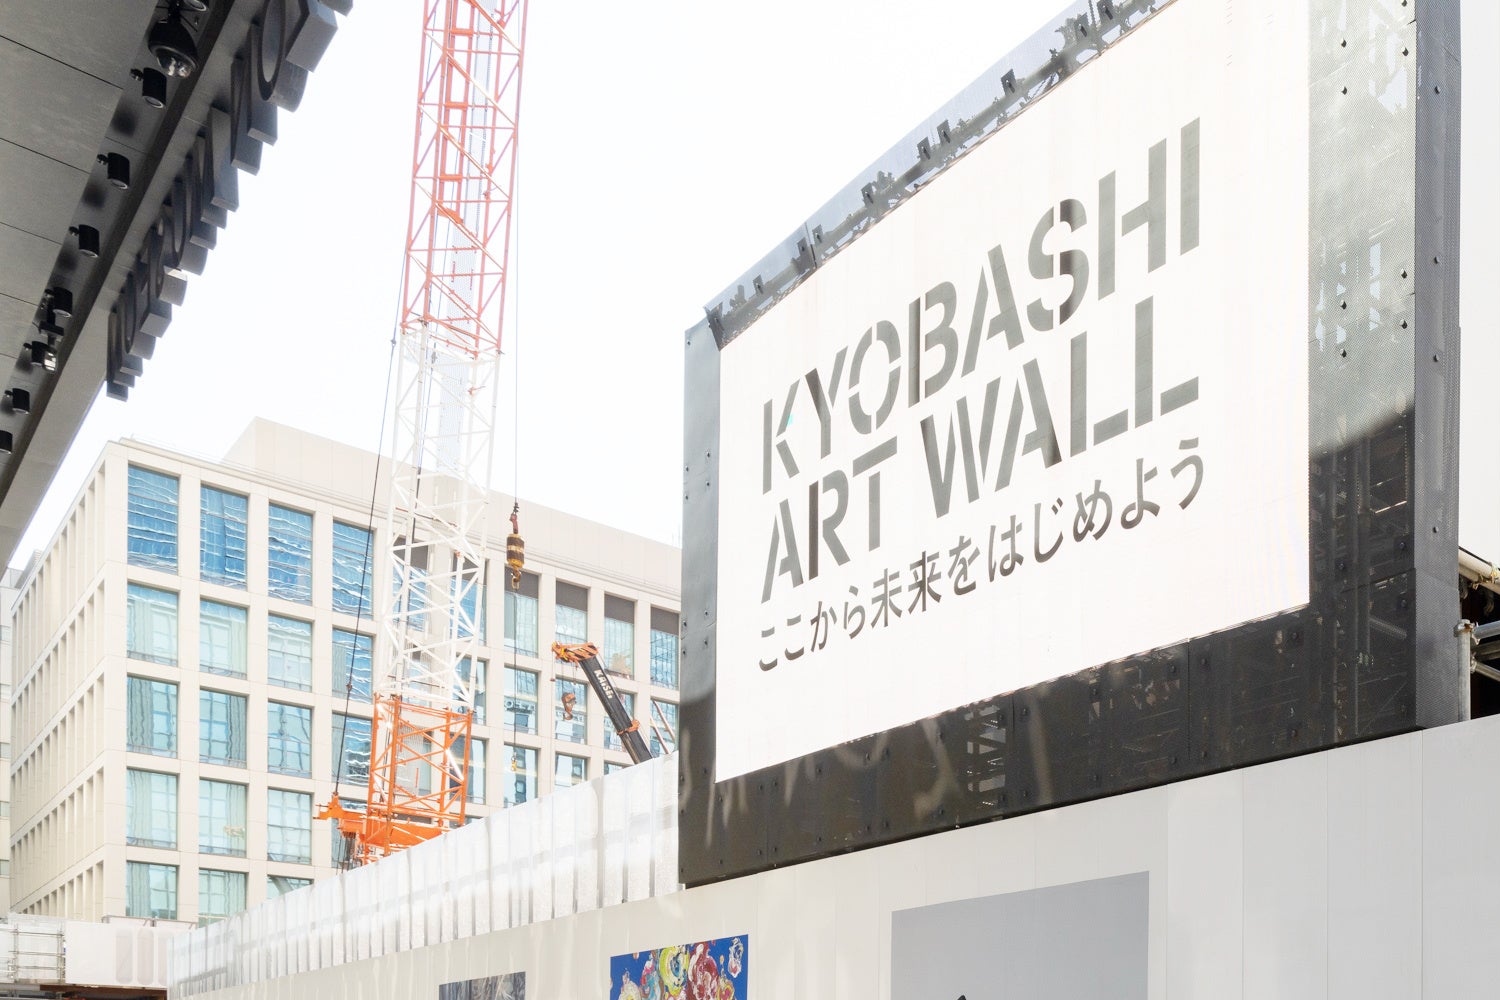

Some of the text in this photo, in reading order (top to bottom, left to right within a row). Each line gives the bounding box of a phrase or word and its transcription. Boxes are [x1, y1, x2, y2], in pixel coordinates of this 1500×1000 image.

[761, 295, 1199, 604] ART WALL
[762, 116, 1200, 495] KYOBASHI
[759, 437, 1205, 672] ここから未来をはじめよう
